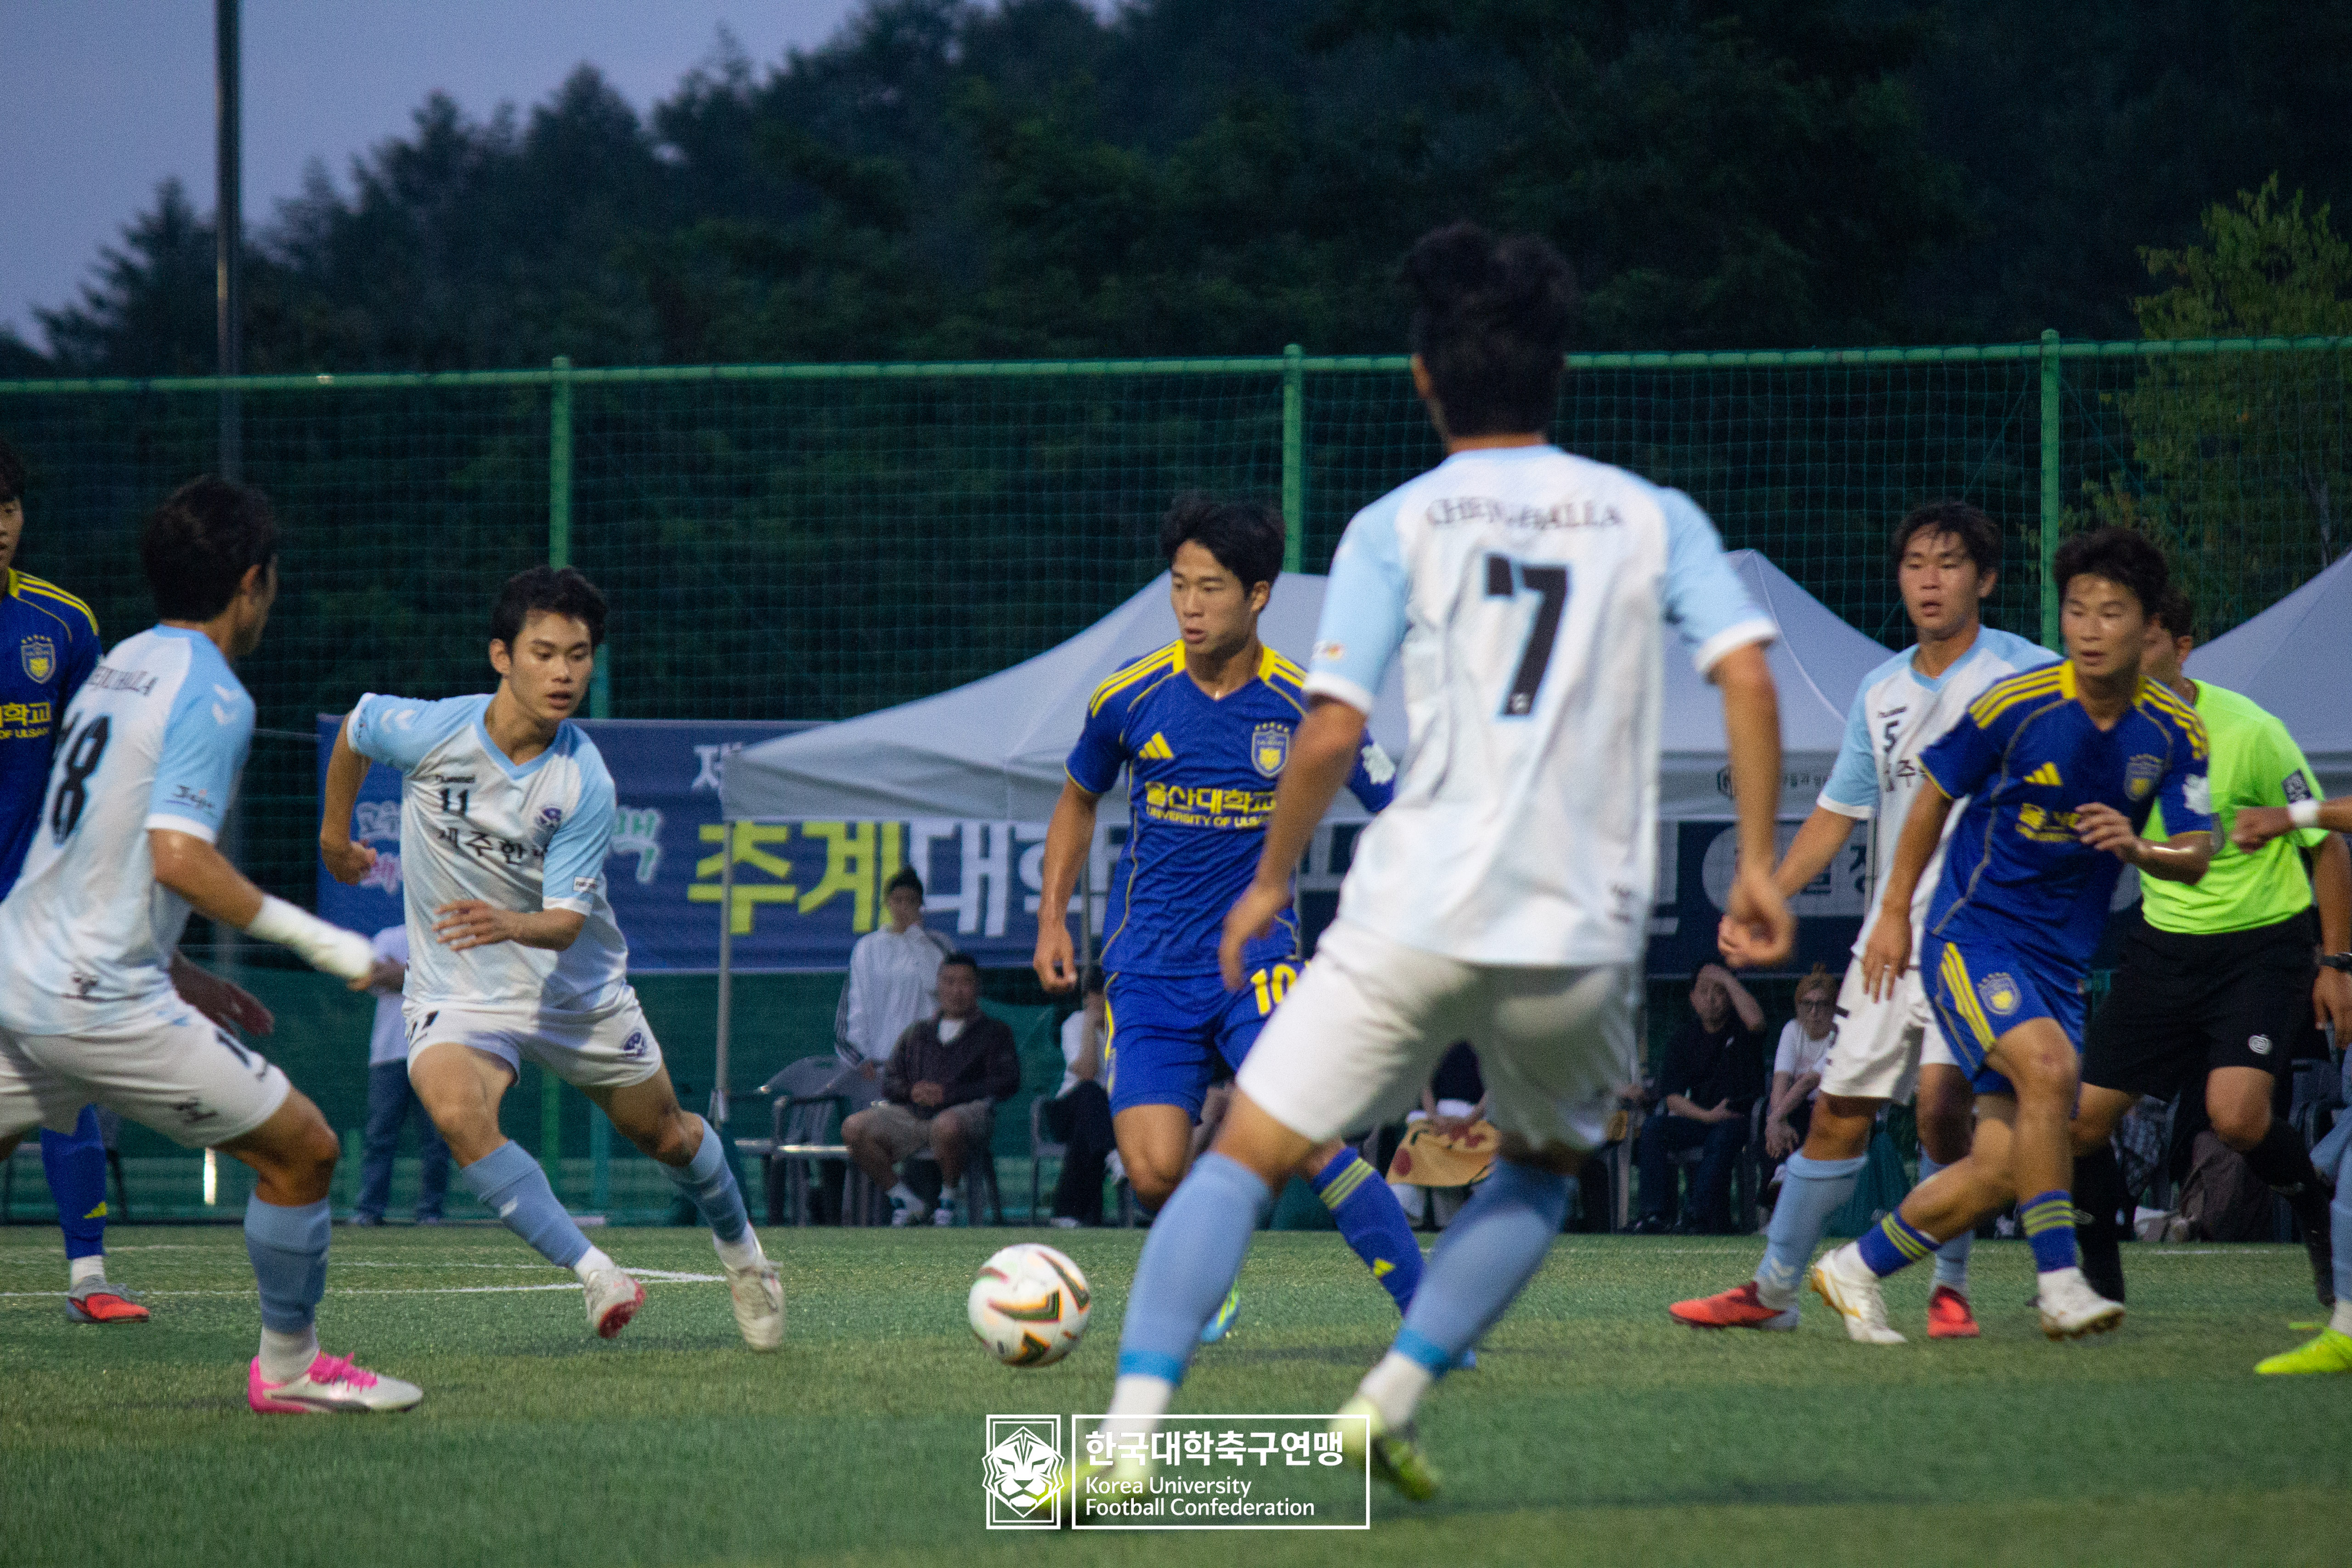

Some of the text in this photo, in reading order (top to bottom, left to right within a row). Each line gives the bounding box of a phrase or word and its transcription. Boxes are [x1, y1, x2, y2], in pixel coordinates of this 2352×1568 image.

[1487, 553, 1569, 716] 7
[0, 702, 51, 729] 학교
[1884, 719, 1899, 754] 5
[440, 787, 469, 817] 11
[1250, 963, 1297, 1016] 10
